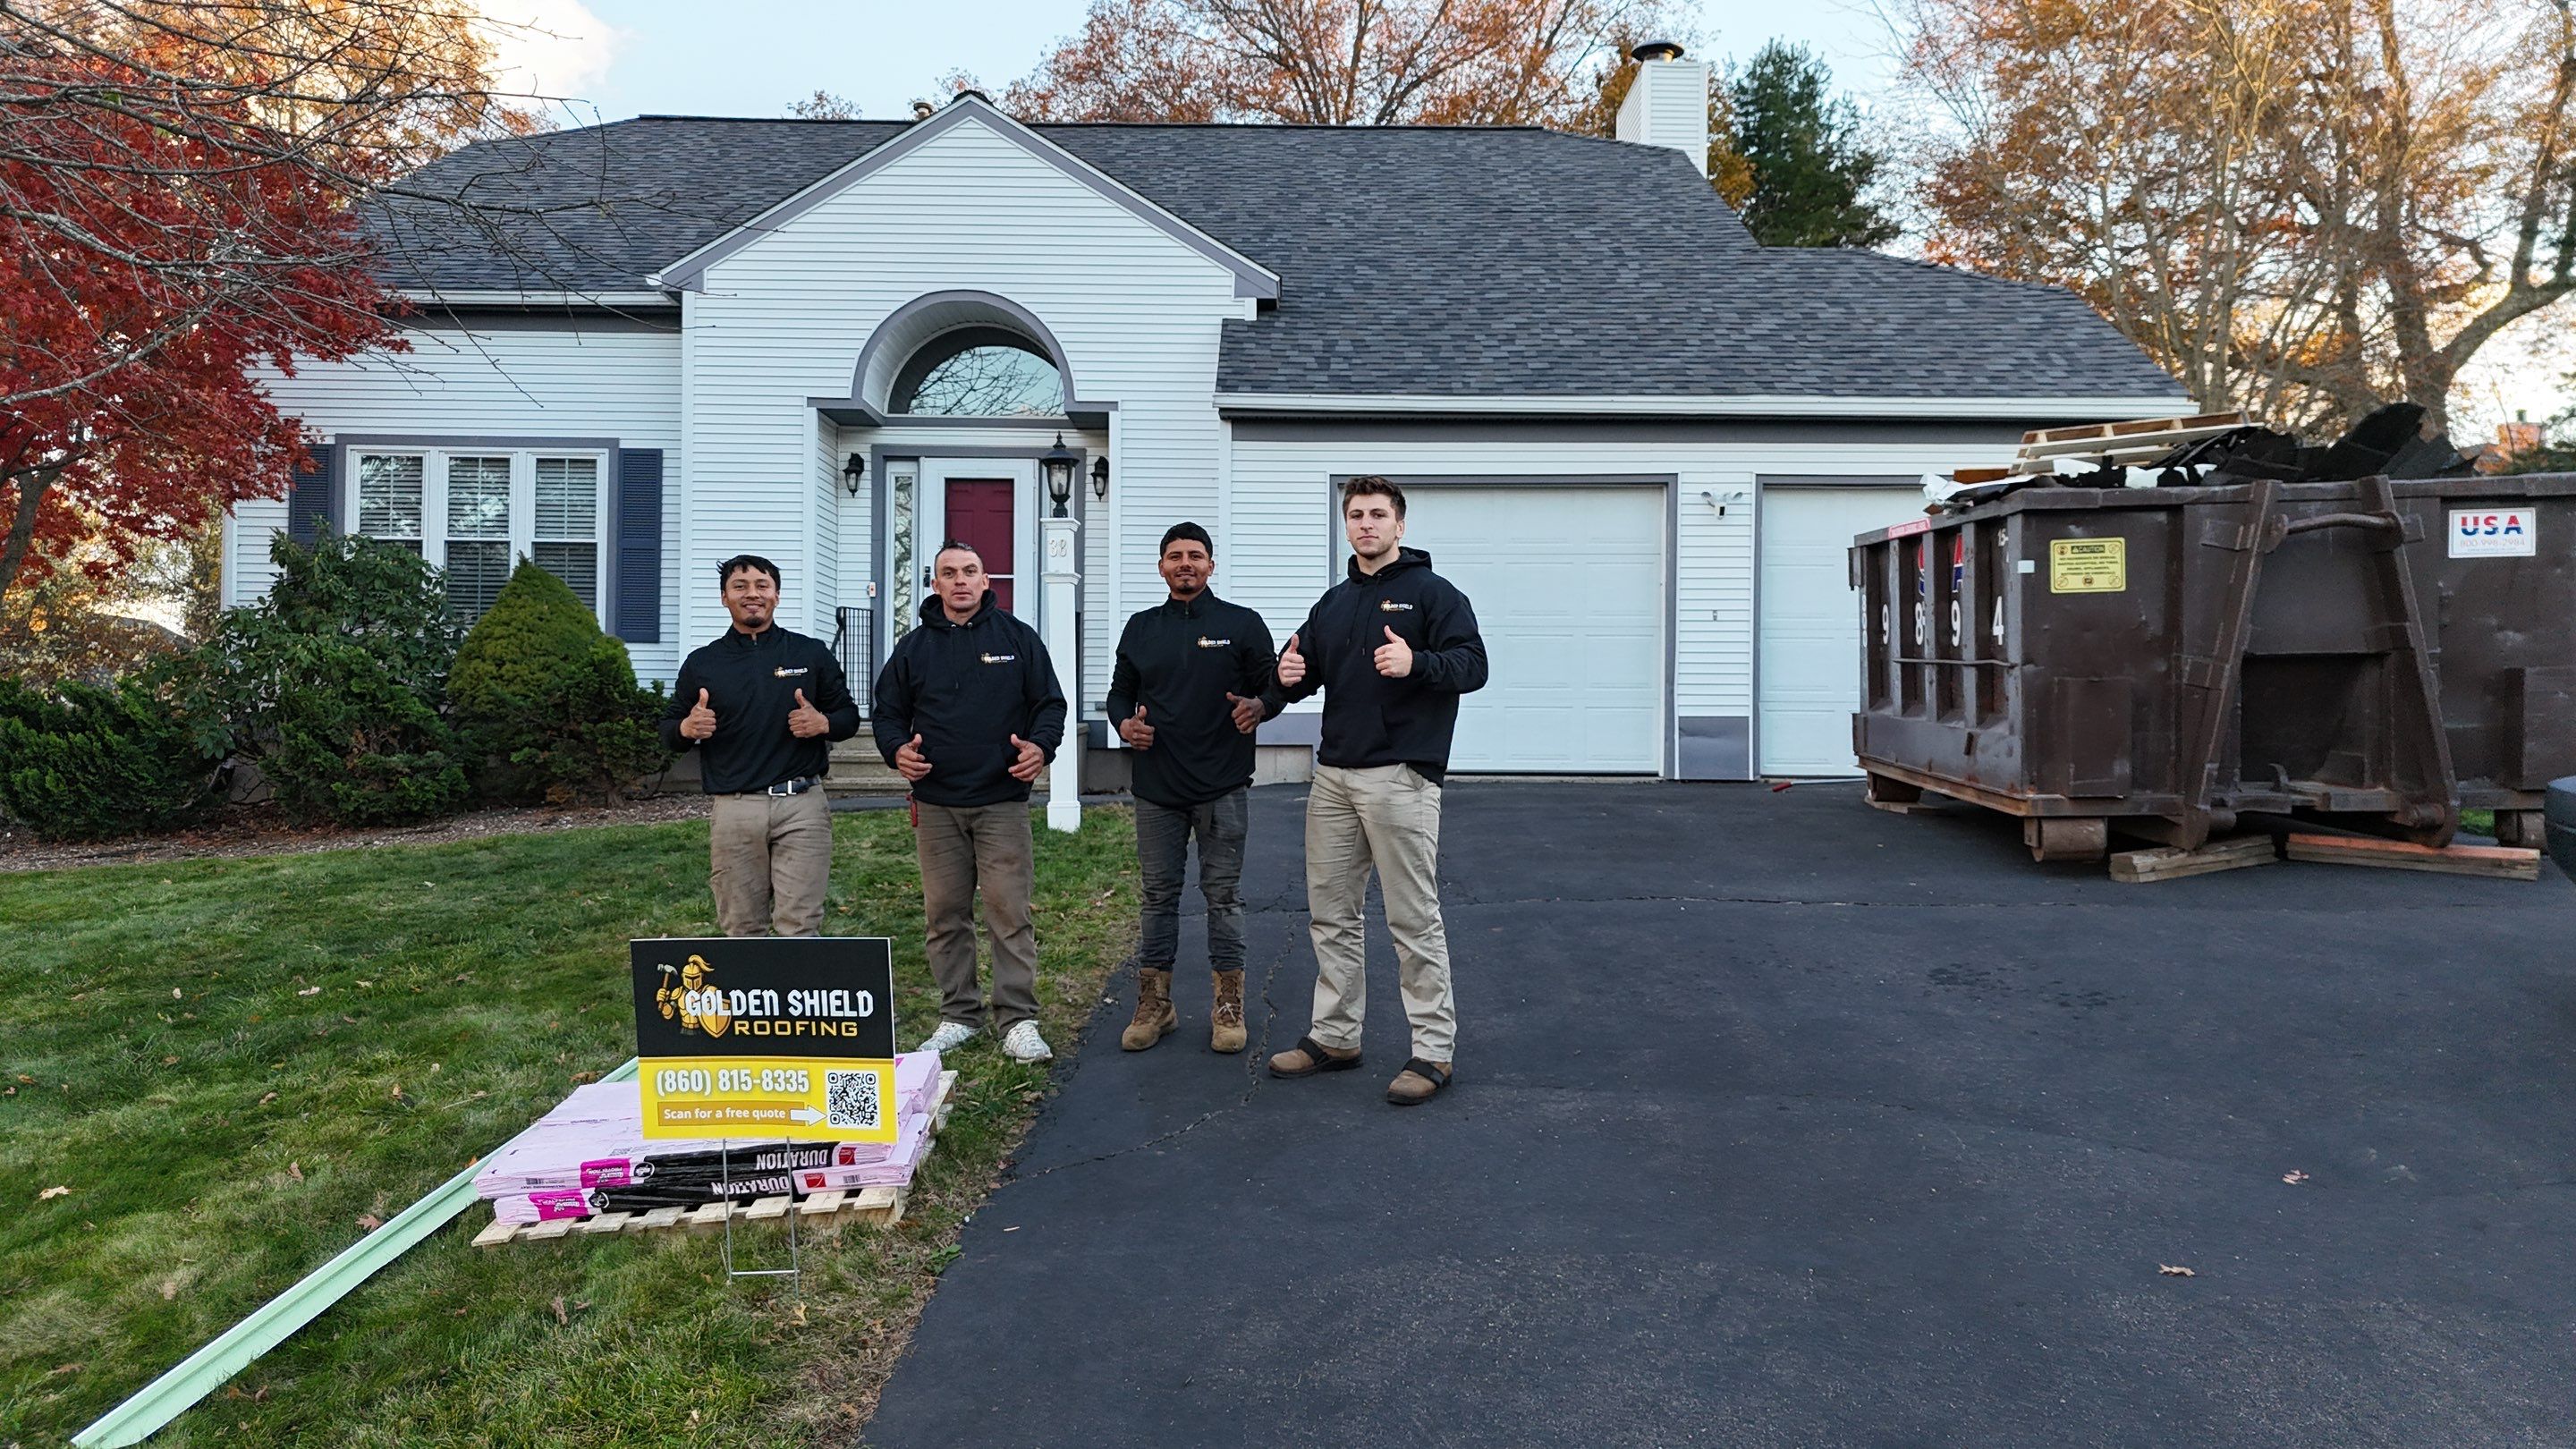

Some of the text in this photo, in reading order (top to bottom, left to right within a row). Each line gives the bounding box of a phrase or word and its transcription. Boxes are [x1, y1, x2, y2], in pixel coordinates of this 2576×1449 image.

[2462, 515, 2523, 536] USA
[1049, 538, 1067, 557] 38
[684, 989, 874, 1017] GOLDEN SHIELD
[733, 1020, 858, 1037] ROOFING
[657, 1068, 809, 1097] (860) 815-8335
[664, 1106, 785, 1120] Scan for a free quote
[756, 1149, 828, 1171] DURATION
